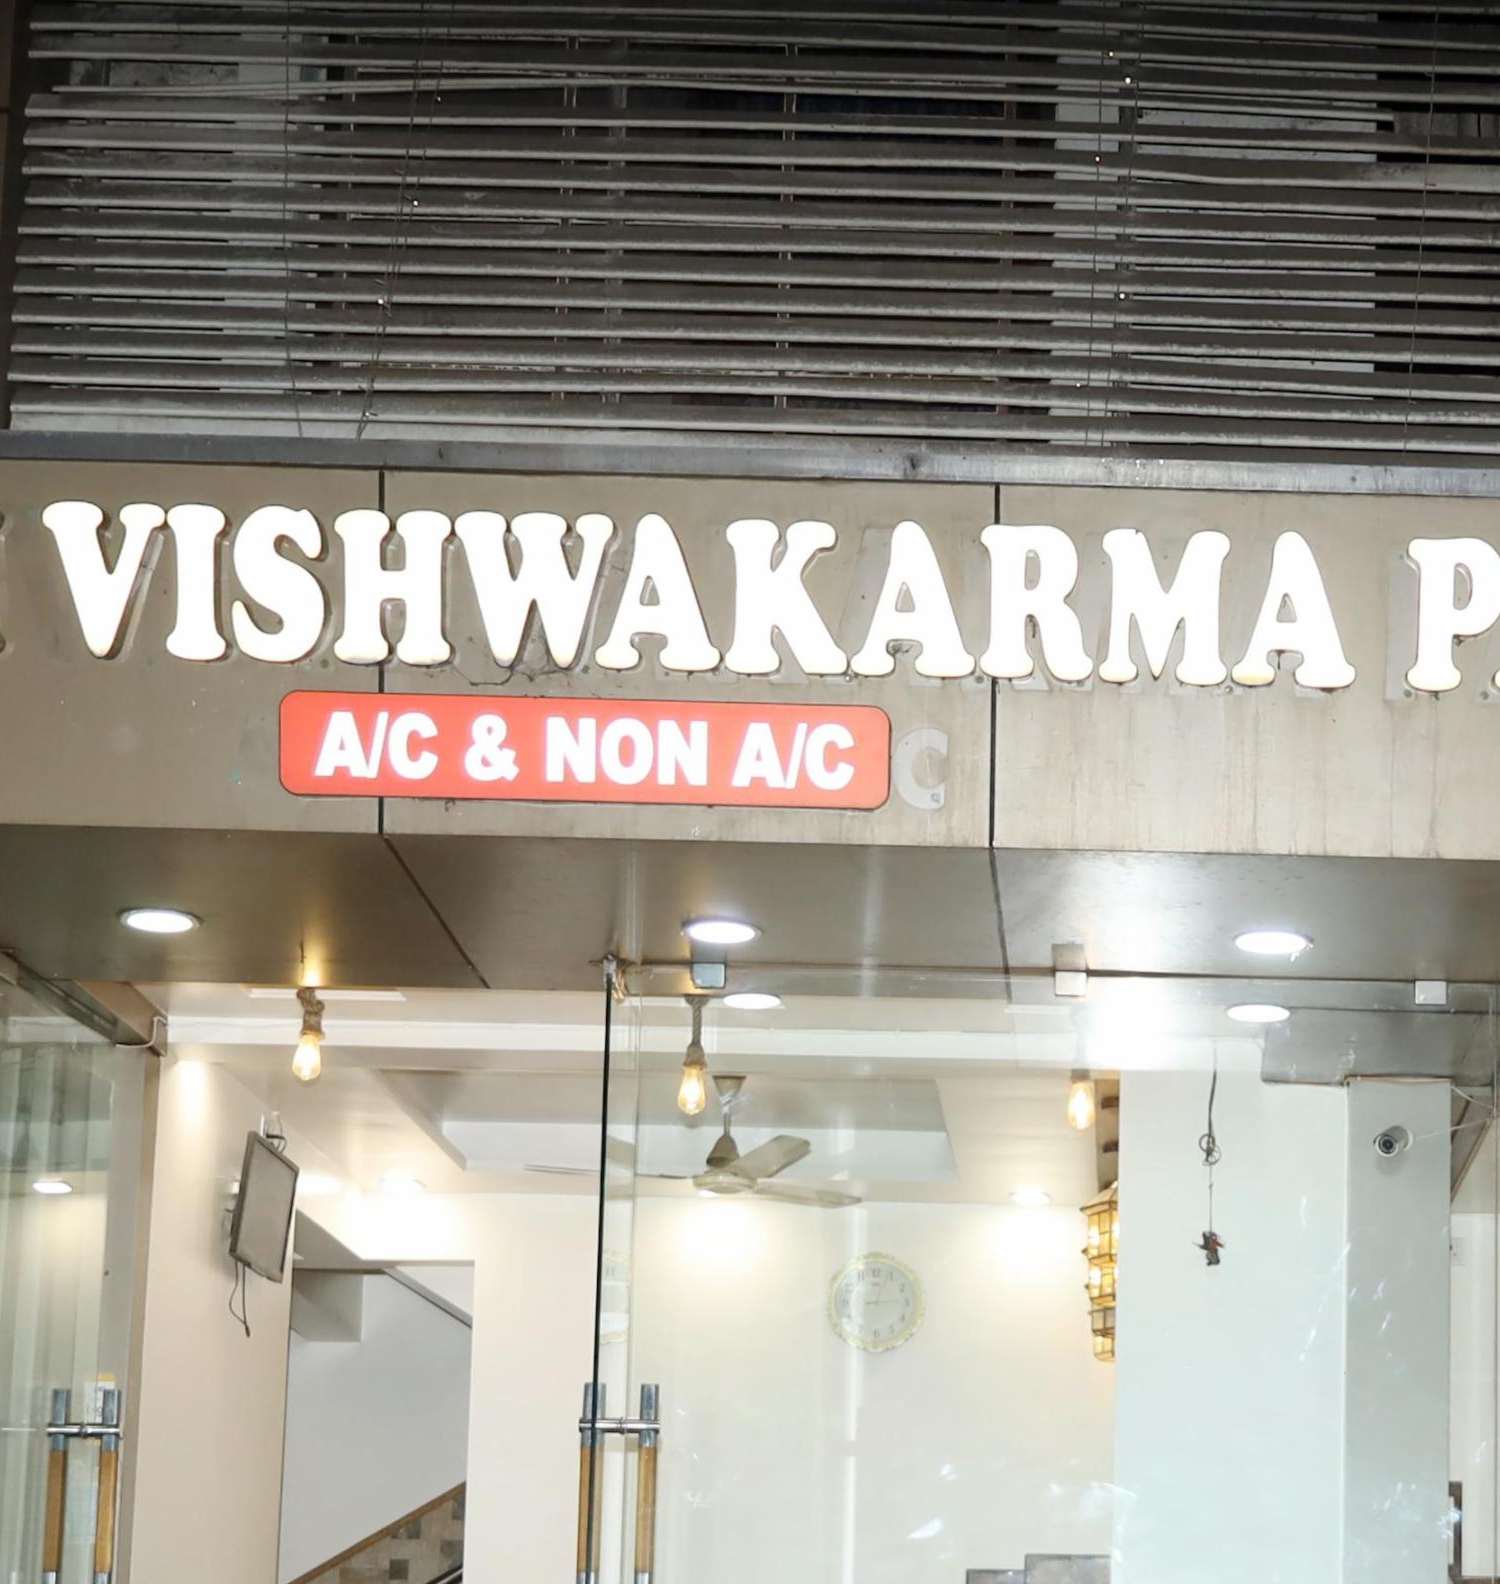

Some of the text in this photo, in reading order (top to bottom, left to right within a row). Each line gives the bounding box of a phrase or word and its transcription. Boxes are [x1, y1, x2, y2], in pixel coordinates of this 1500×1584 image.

[42, 497, 1357, 688] VISHWAKARMA
[314, 710, 855, 791] A/C & NON A/C
